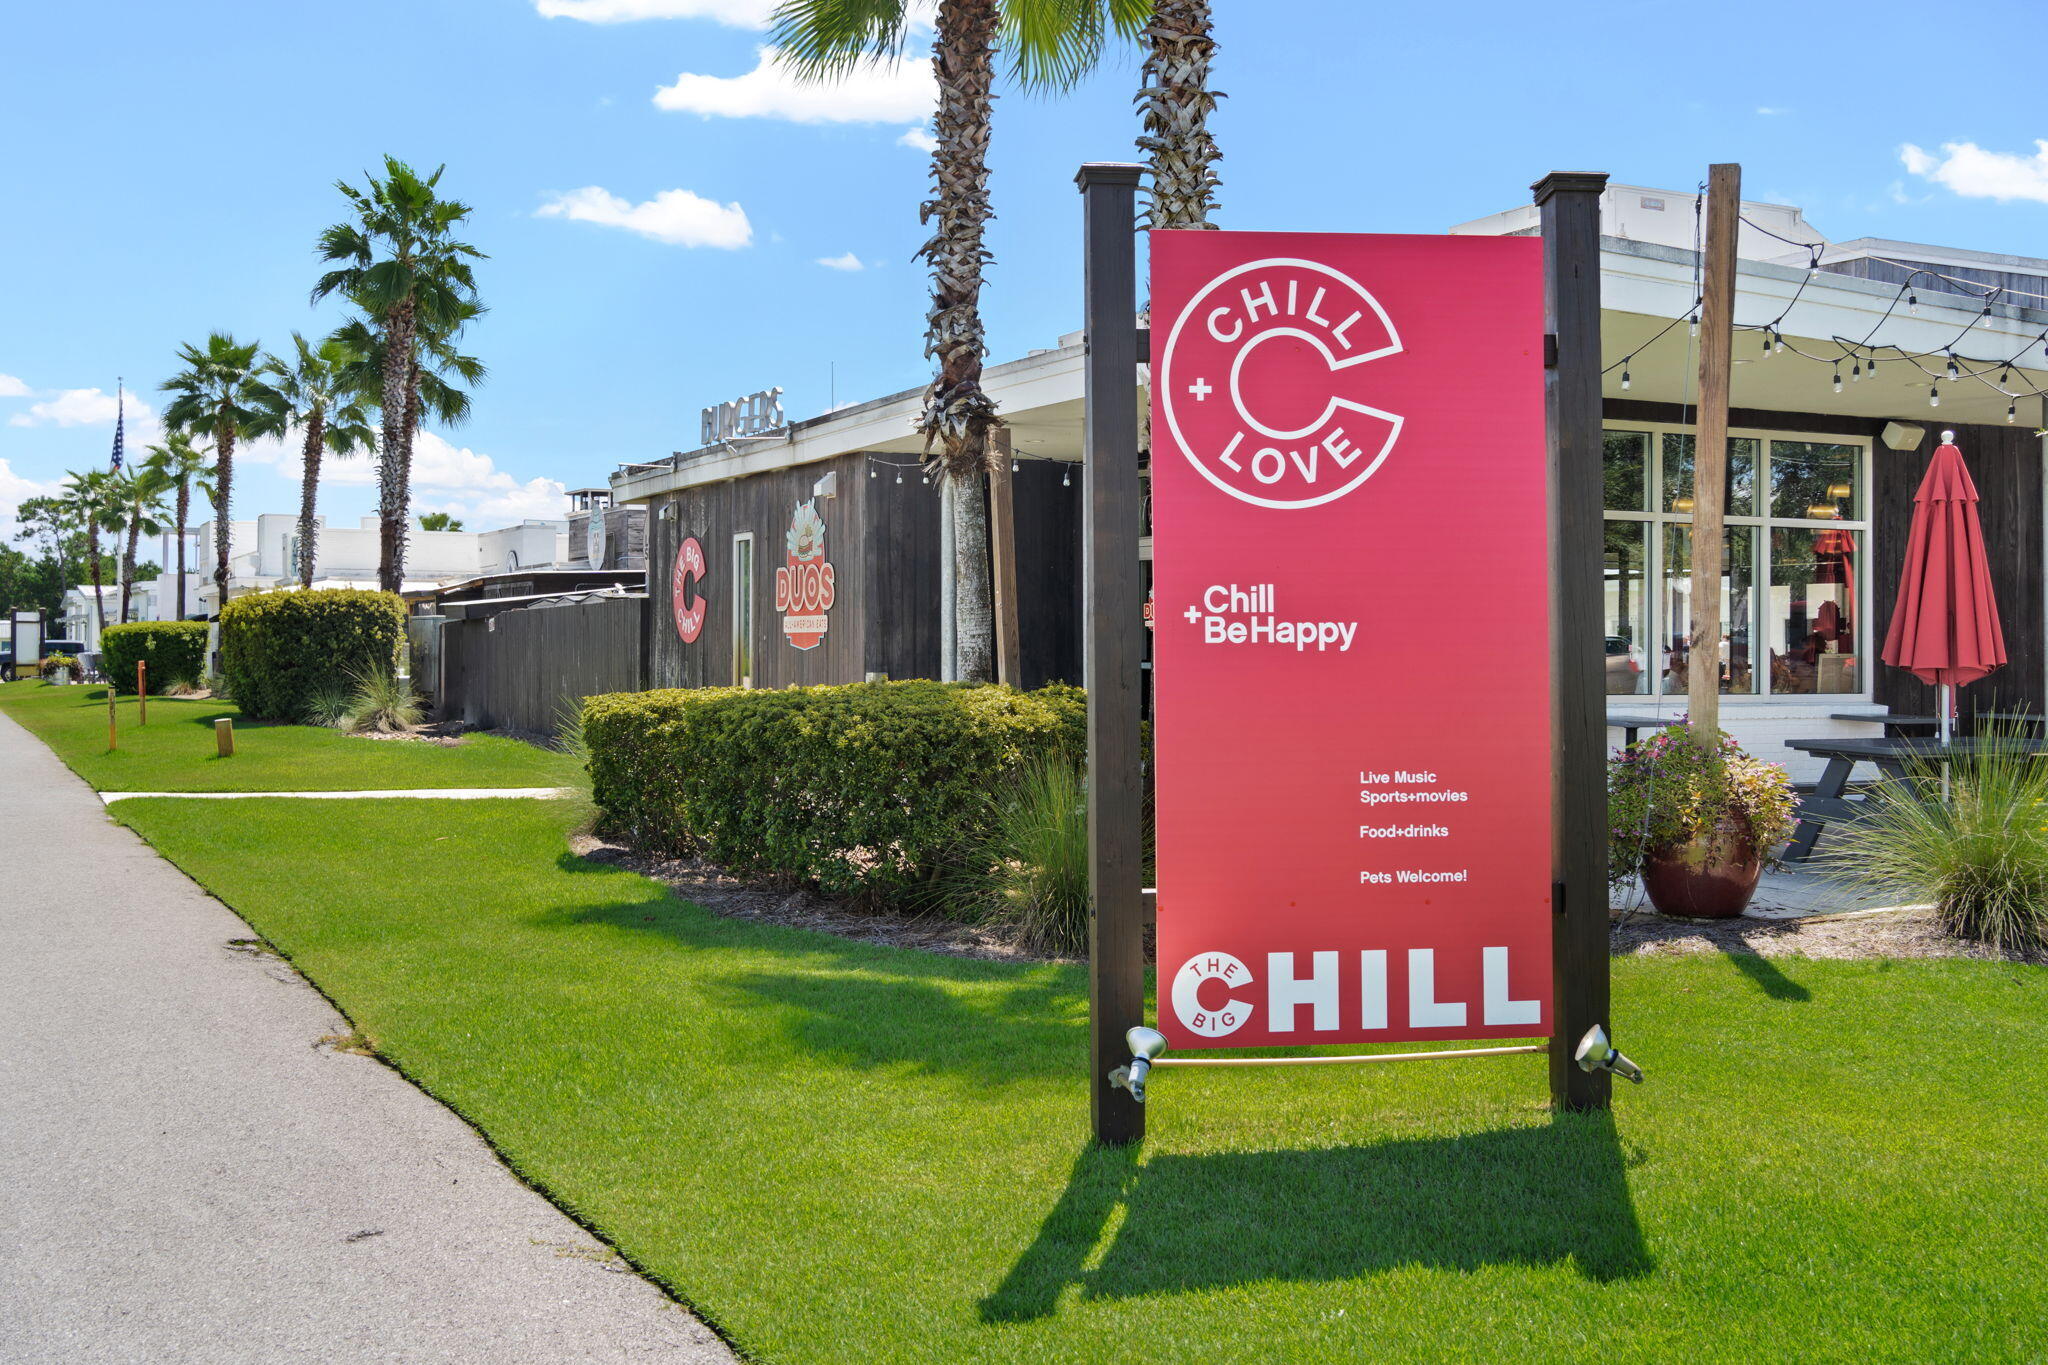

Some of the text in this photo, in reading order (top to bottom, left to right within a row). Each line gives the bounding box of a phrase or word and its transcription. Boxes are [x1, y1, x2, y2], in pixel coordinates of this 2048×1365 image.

[1207, 279, 1362, 350] CHILL
[1219, 427, 1363, 485] LOVE
[686, 546, 700, 572] BIG
[776, 563, 835, 612] DUOS
[1203, 583, 1275, 614] Chill
[677, 608, 701, 634] CHILL
[1360, 770, 1437, 784] Live Music
[1360, 789, 1468, 807] Sports+movies
[1360, 824, 1449, 839] Food+drinks
[1360, 869, 1467, 884] Pets Welcome!
[1189, 957, 1239, 980] THE
[1192, 1011, 1236, 1032] BIG
